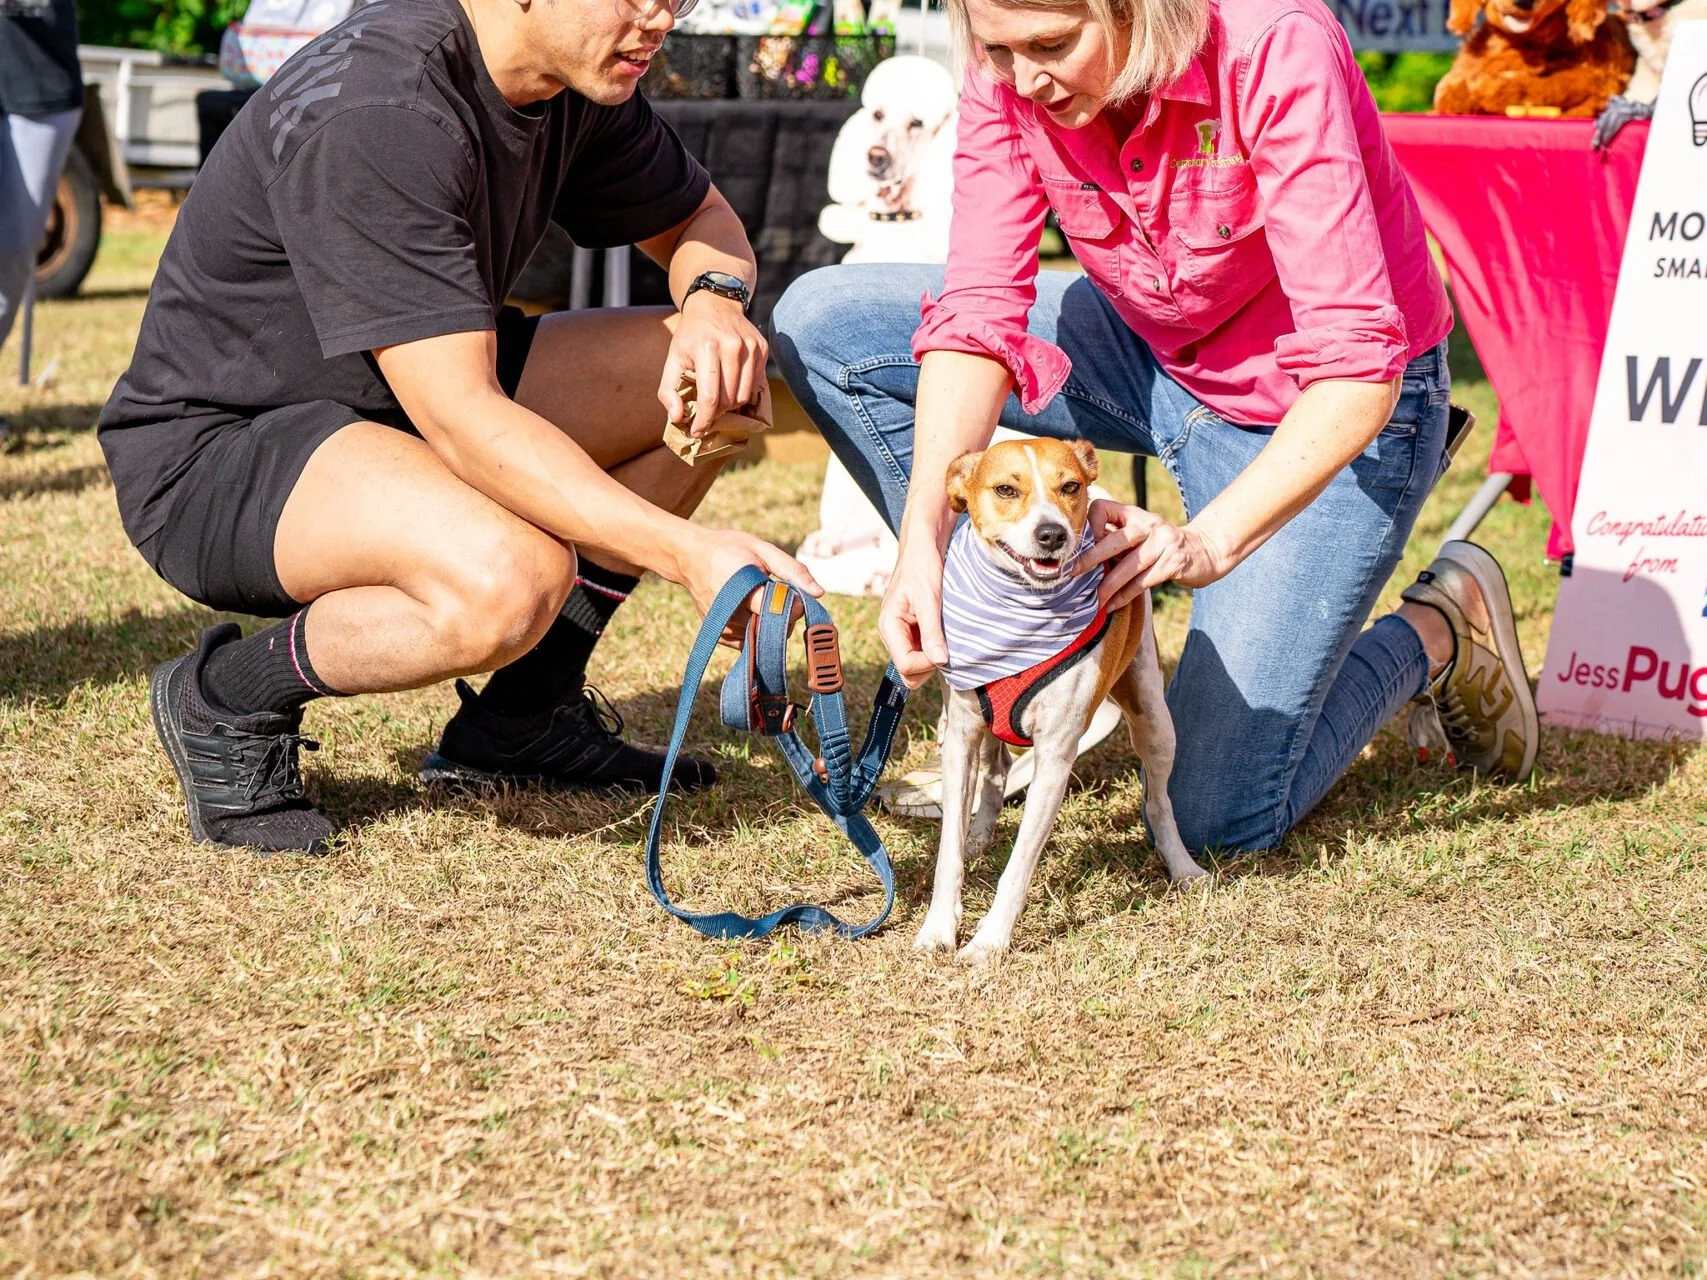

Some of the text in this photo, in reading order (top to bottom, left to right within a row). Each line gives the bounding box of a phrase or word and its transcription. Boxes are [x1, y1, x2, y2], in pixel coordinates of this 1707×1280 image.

[1649, 211, 1705, 242] MO
[1653, 257, 1707, 279] SMA
[1626, 355, 1707, 427] W
[1622, 546, 1679, 584] from
